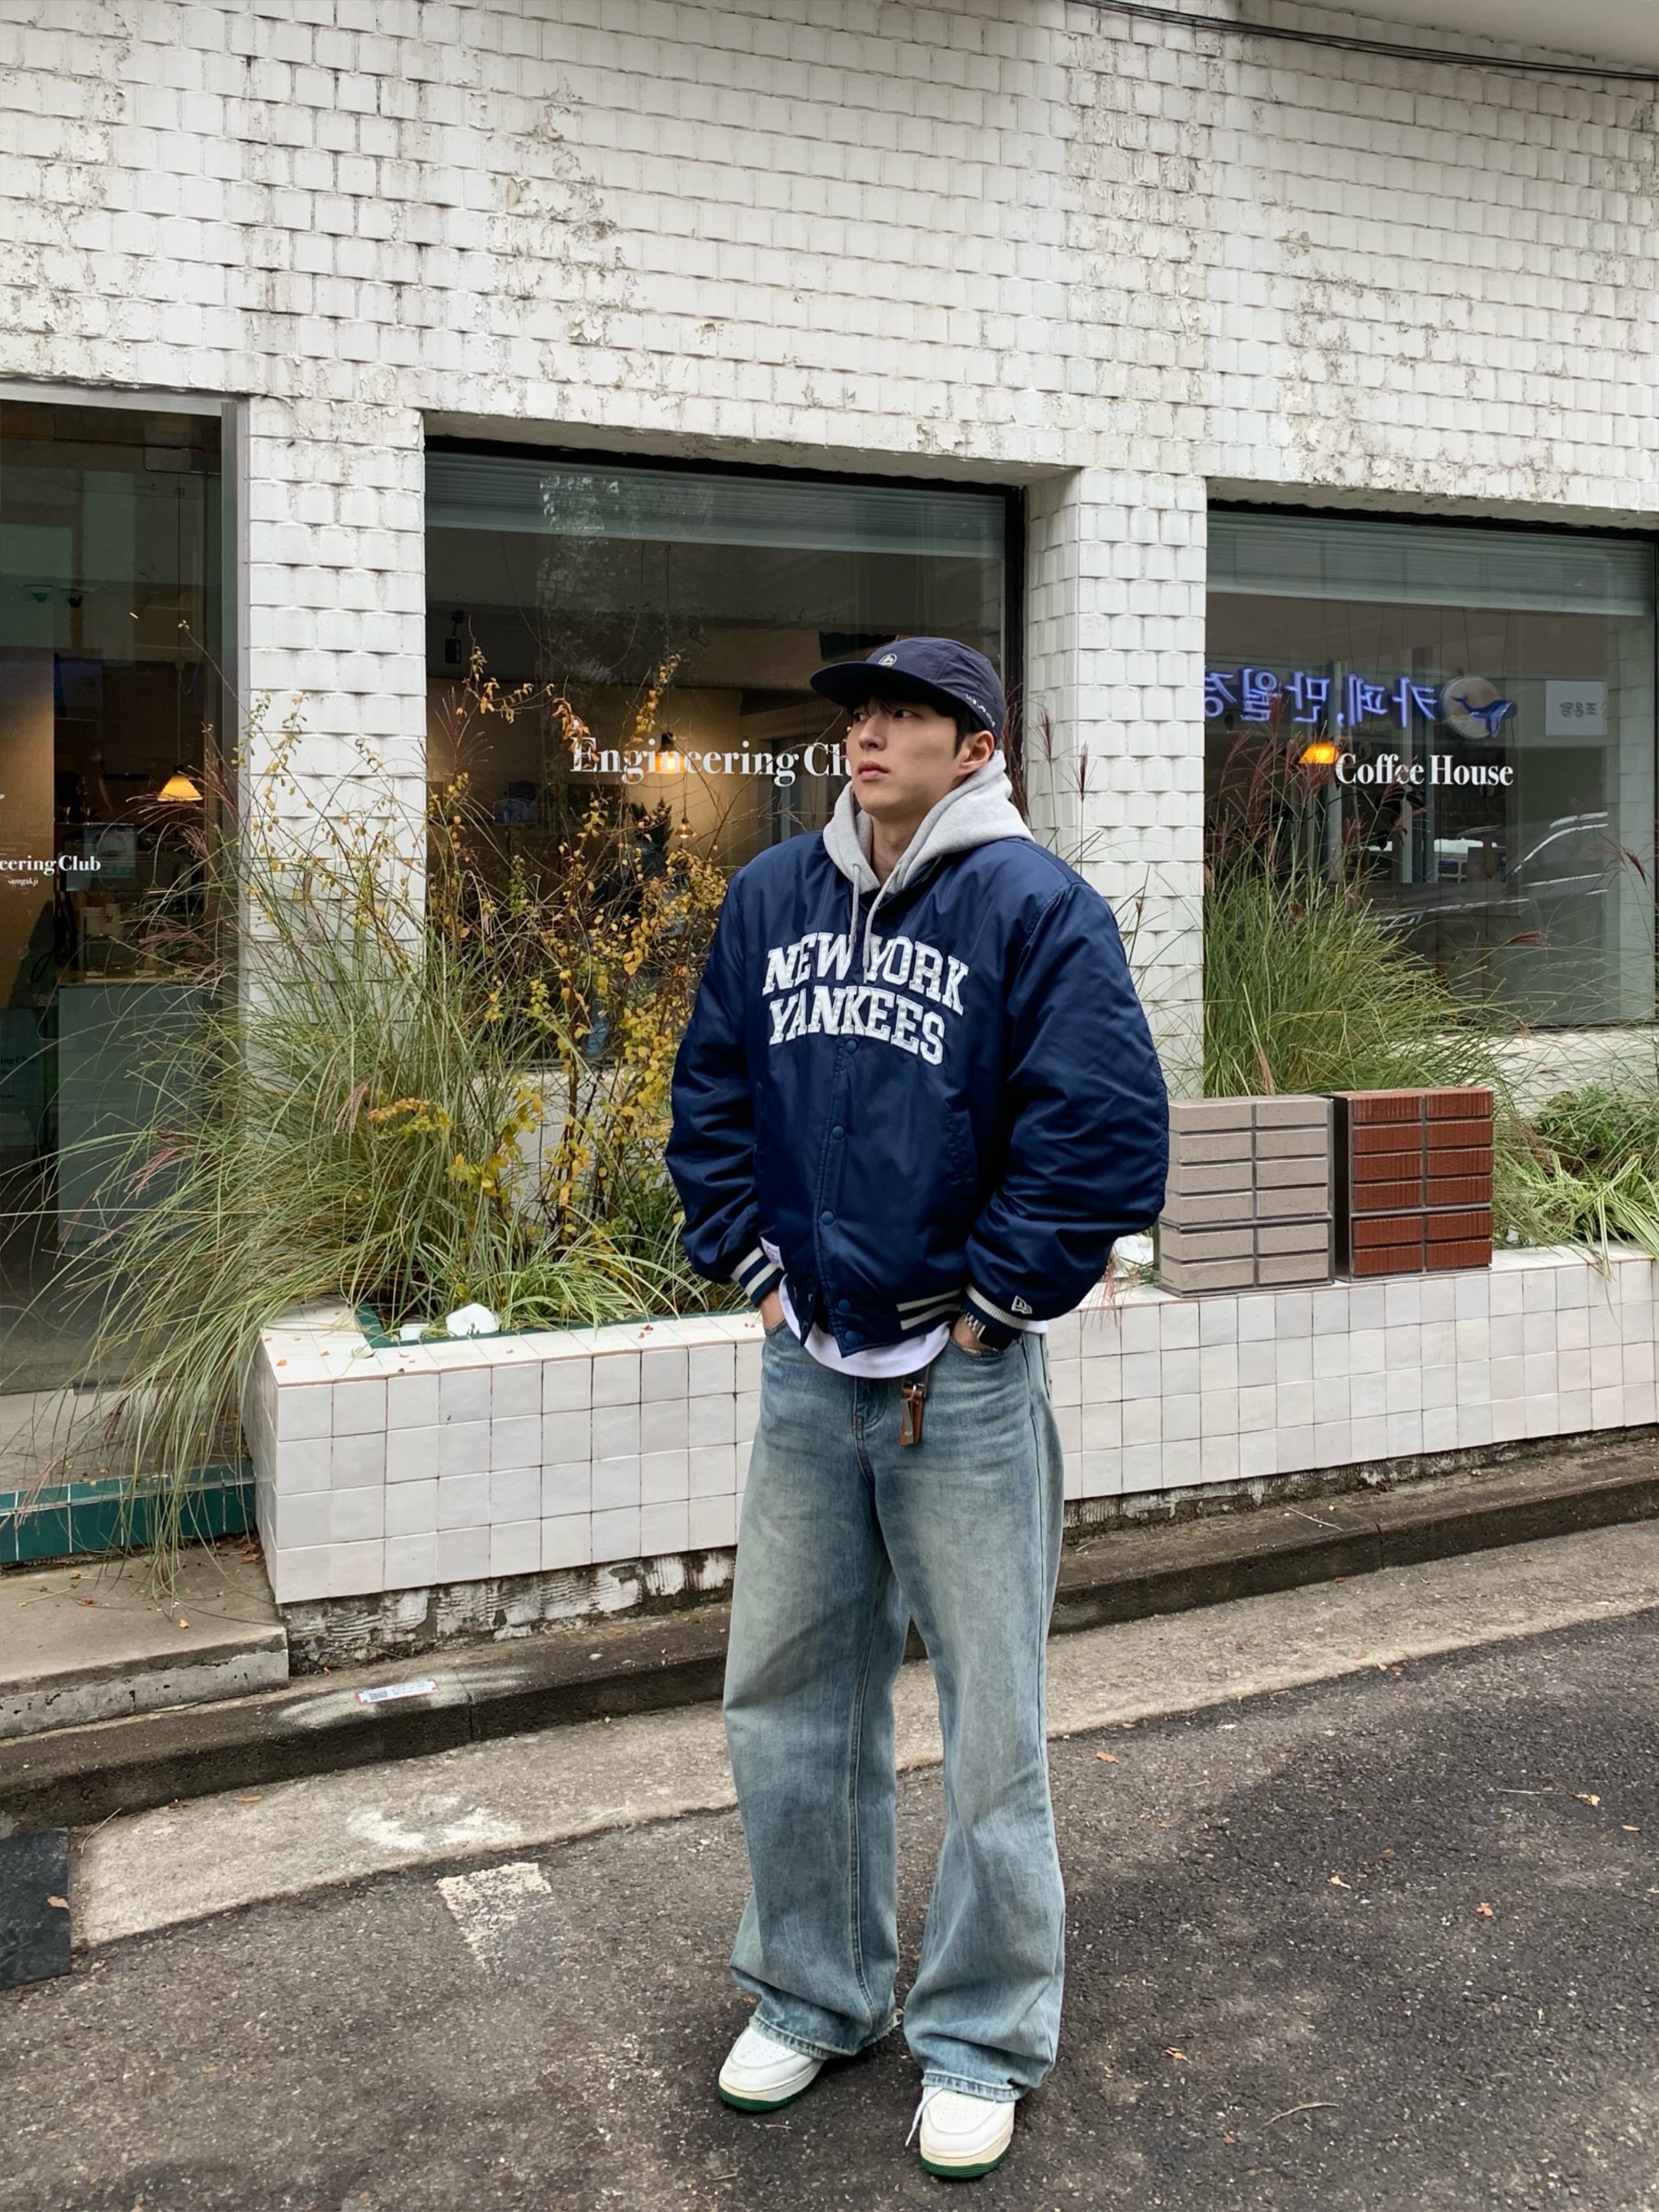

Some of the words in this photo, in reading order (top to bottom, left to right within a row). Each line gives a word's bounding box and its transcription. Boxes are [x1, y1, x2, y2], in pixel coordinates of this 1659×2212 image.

[570, 737, 799, 787] Engineering
[1335, 753, 1425, 785] Coffee
[1429, 754, 1514, 786] House
[0, 855, 56, 876] eering
[58, 855, 101, 871] Club
[762, 932, 856, 996] NEW
[866, 935, 969, 1016] YORK
[769, 985, 945, 1066] YANKEES
